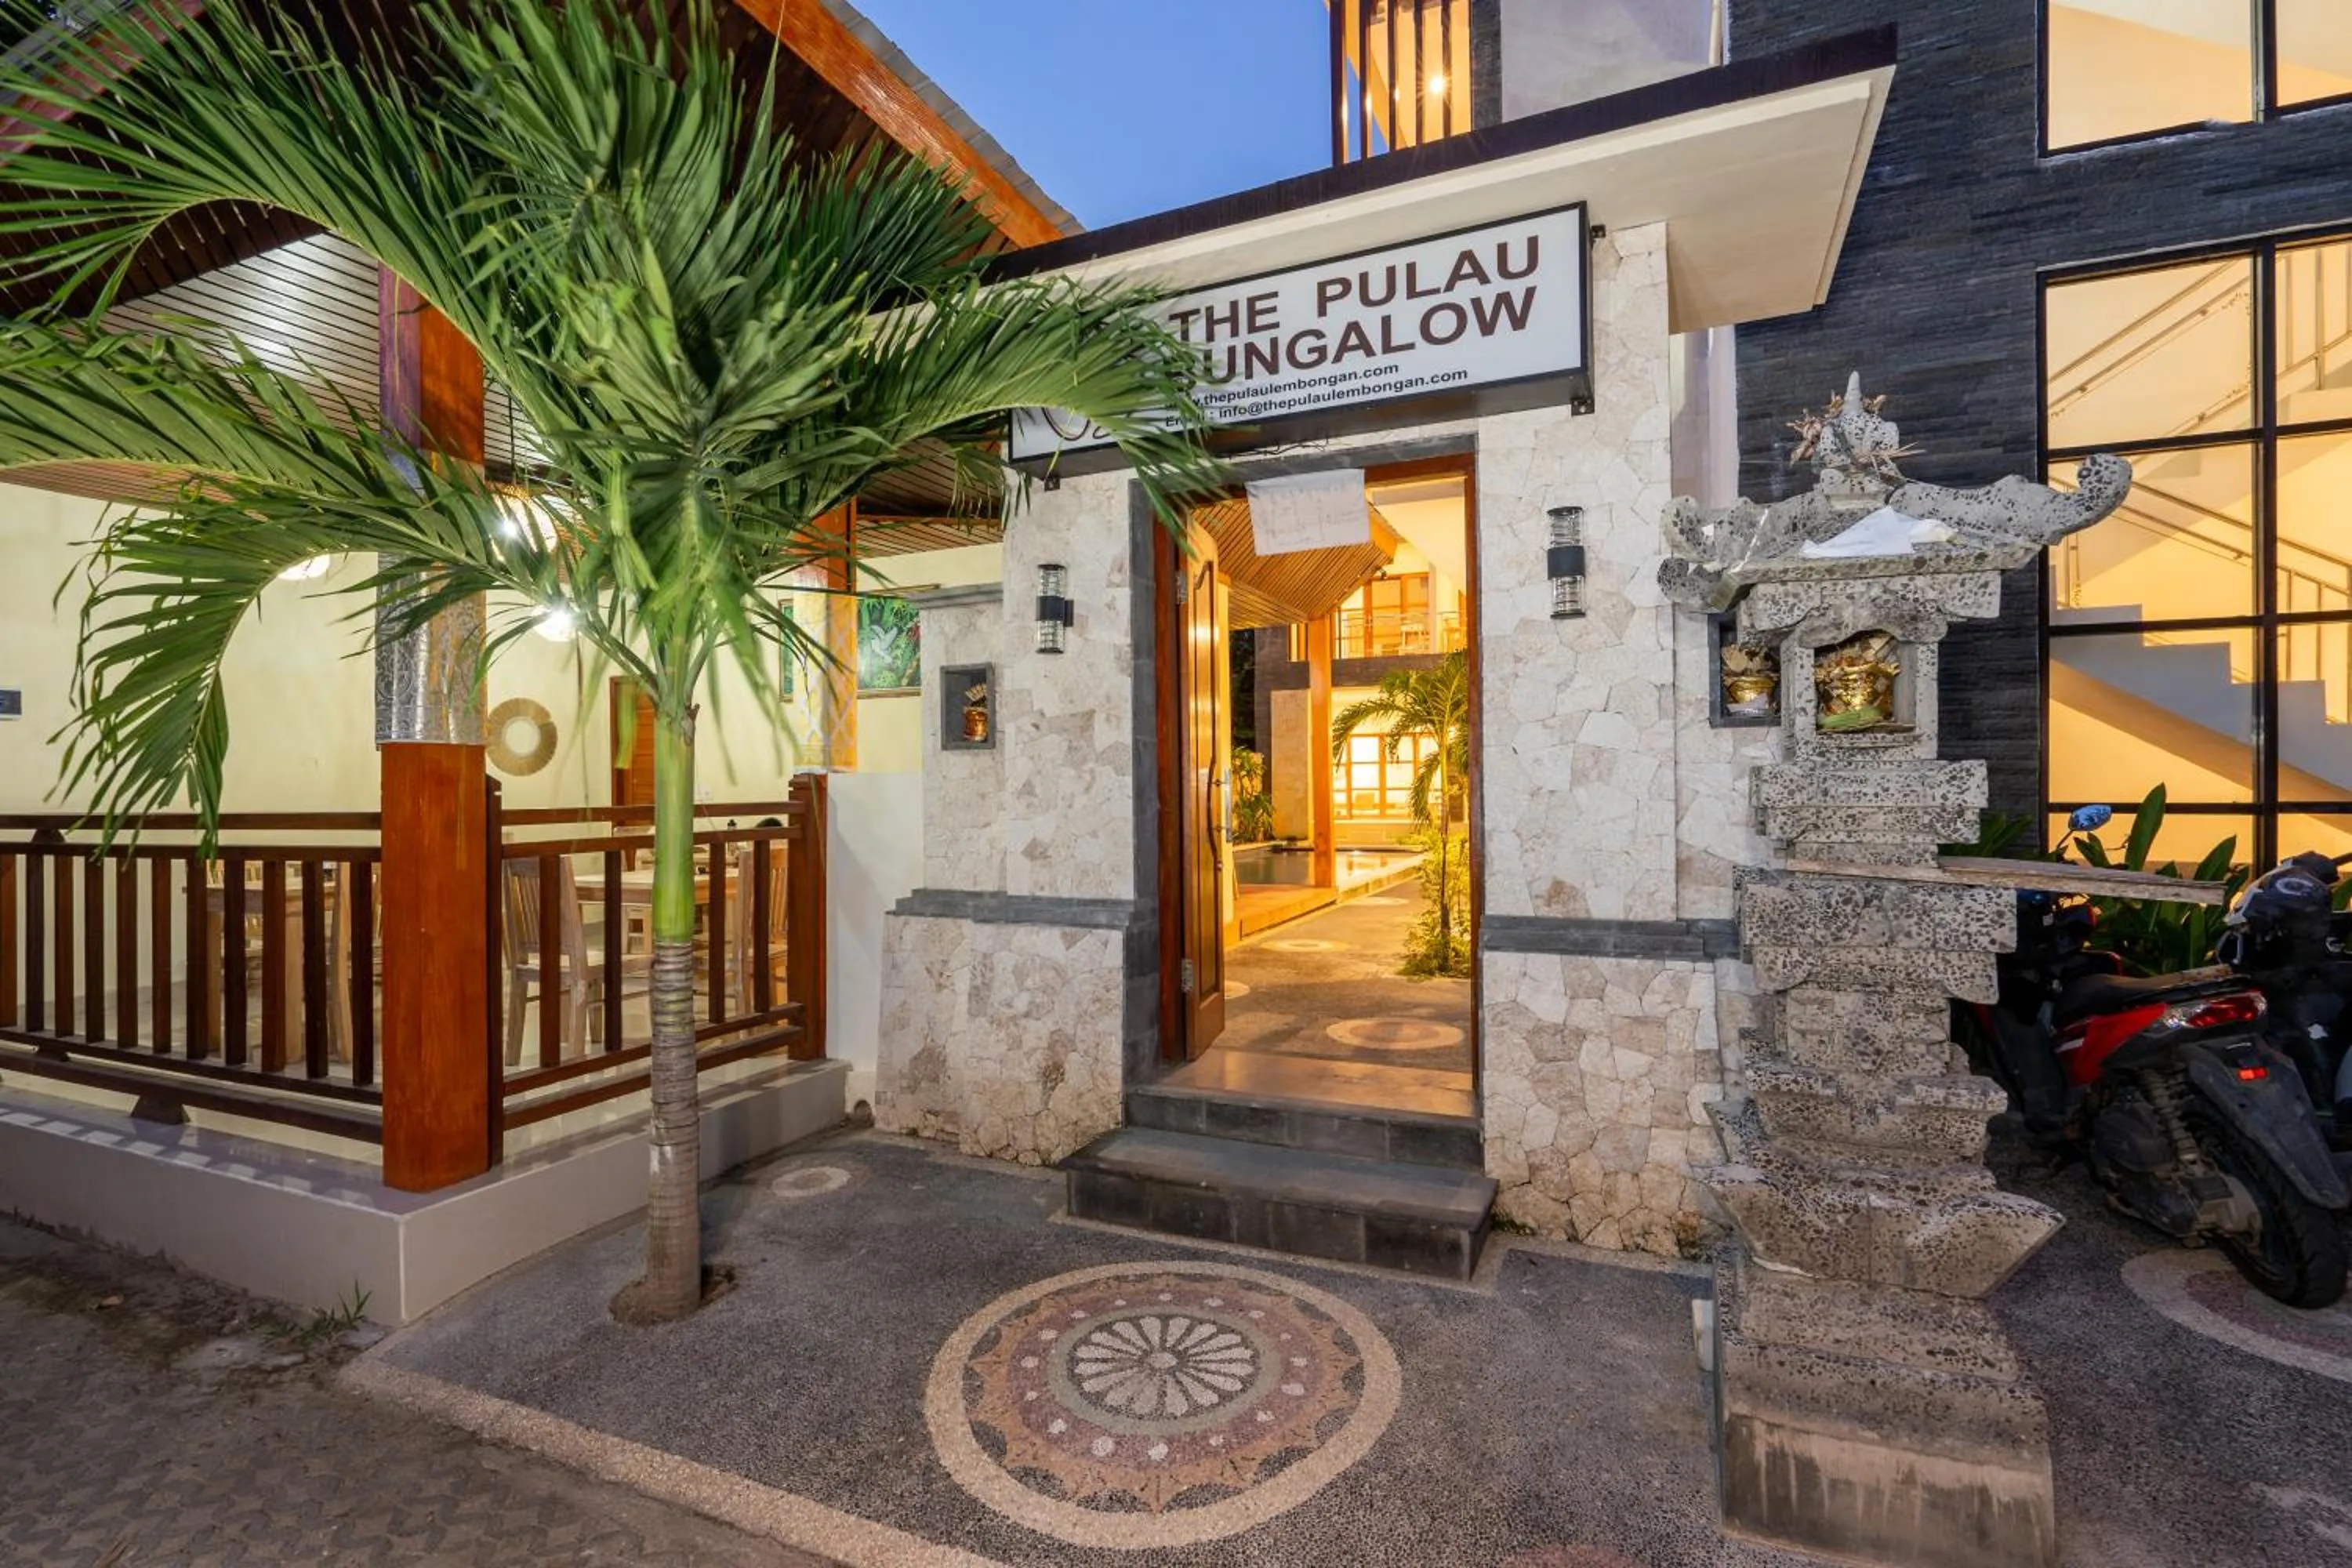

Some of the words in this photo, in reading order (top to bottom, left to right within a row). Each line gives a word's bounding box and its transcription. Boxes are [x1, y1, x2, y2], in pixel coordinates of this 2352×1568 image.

[1167, 291, 1280, 343] THE
[1316, 235, 1540, 318] PULAU
[1219, 369, 1468, 419] info@thepulaulembongan.com
